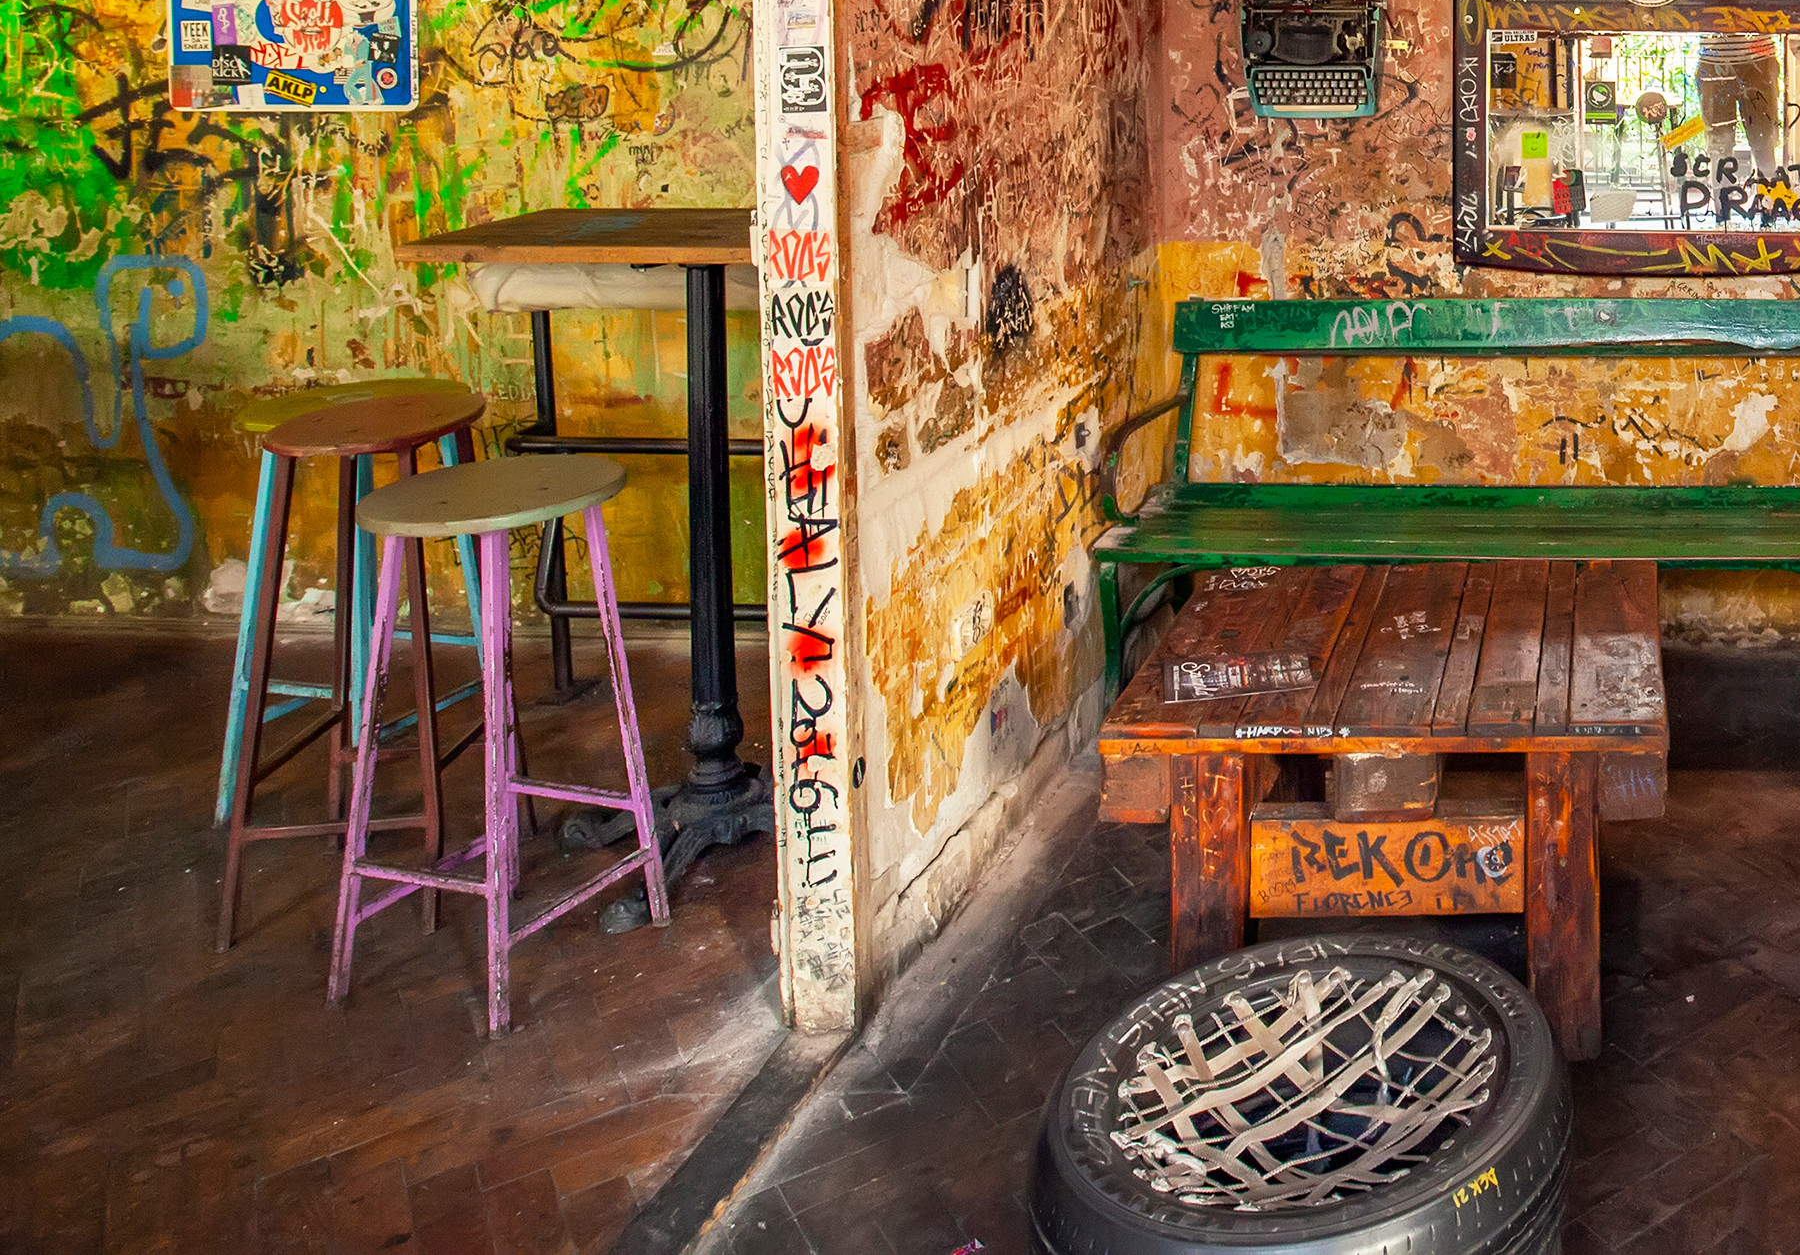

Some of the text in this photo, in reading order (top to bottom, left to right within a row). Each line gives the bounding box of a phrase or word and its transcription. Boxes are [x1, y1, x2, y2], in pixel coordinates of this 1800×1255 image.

[182, 22, 209, 37] YEEK
[1504, 33, 1535, 43] ULTRAS
[183, 43, 210, 51] SNEAK
[267, 76, 315, 101] AKLP
